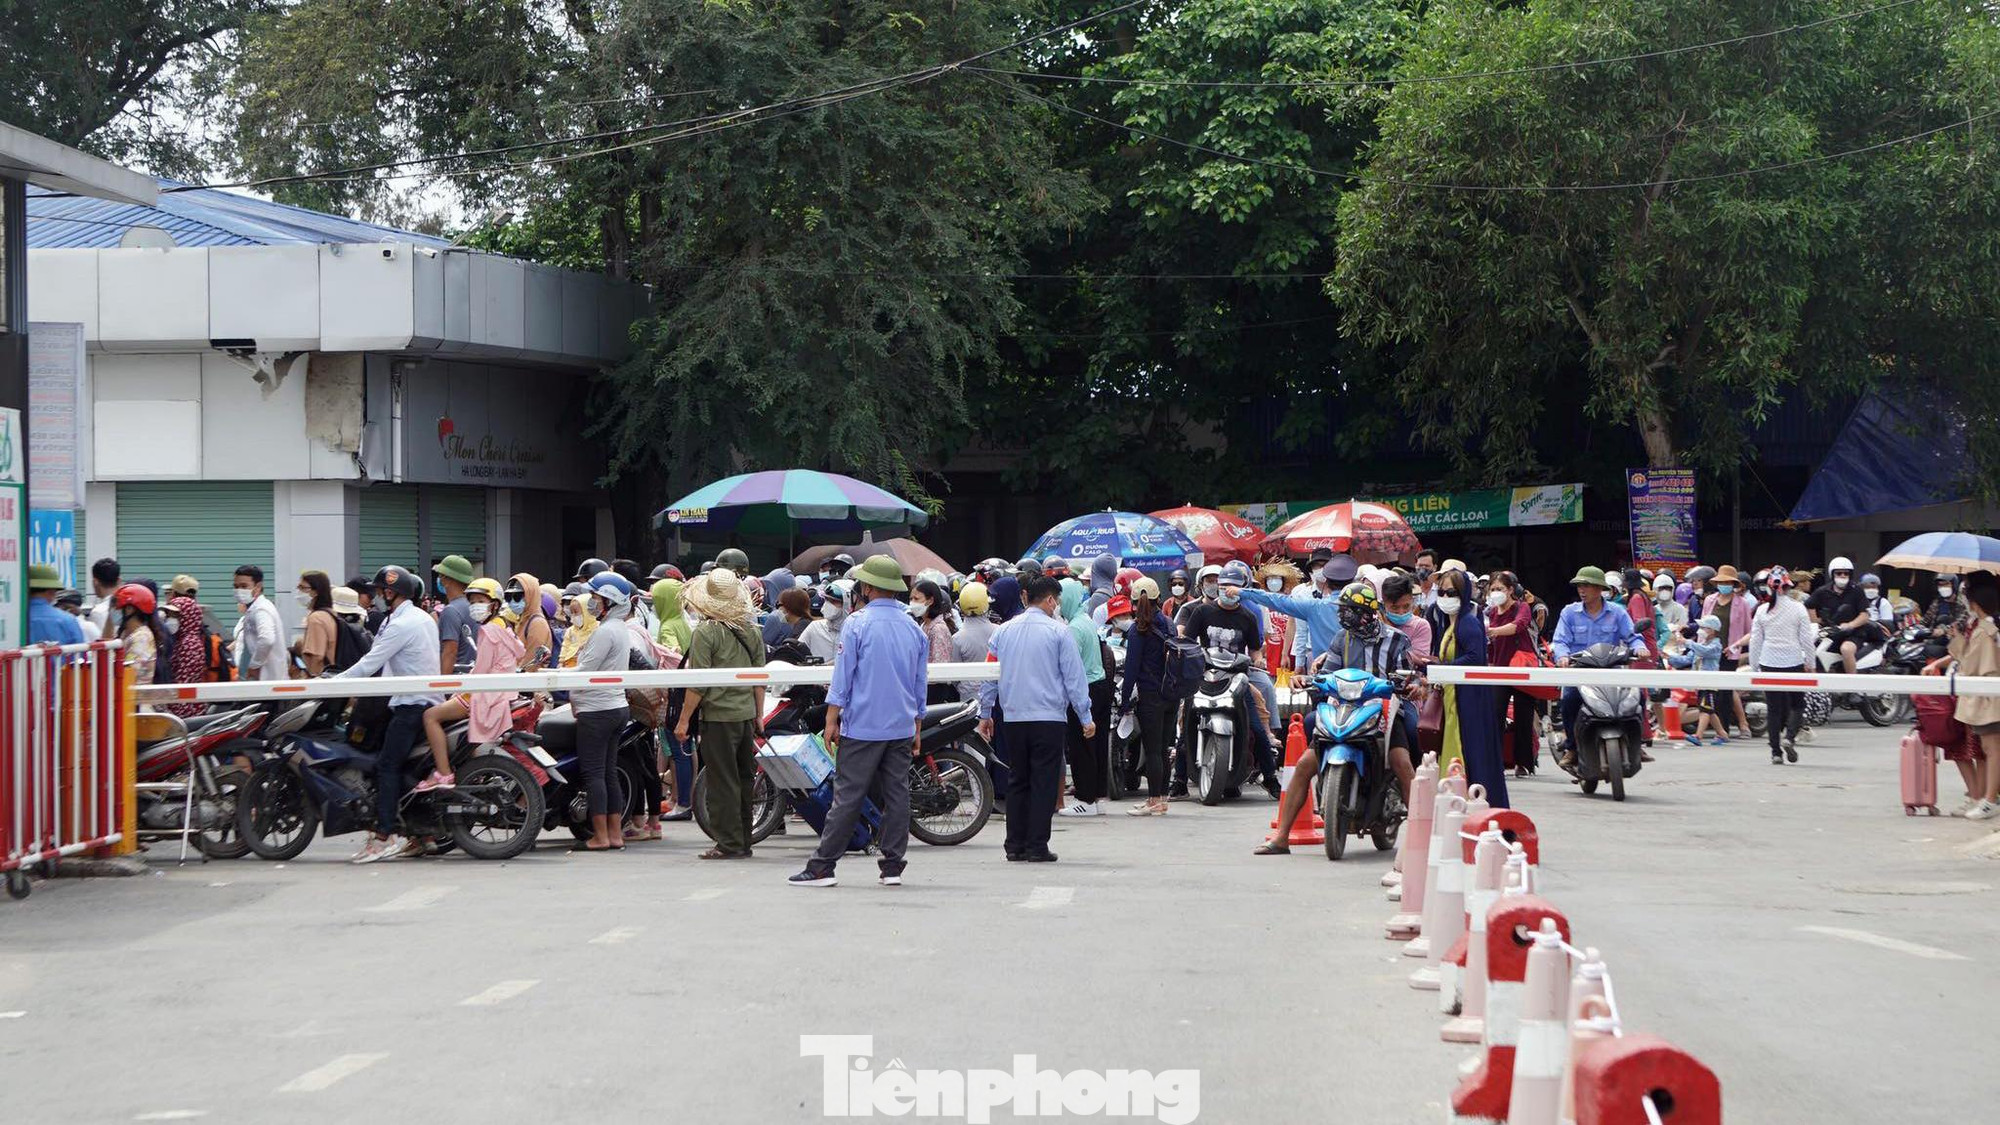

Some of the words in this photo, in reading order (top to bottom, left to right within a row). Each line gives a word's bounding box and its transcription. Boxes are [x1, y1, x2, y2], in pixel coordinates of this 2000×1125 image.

[1413, 494, 1450, 511] LIÊN
[1520, 491, 1544, 514] Sprite
[1433, 511, 1459, 523] CÁC
[1461, 510, 1489, 522] LOẠI
[1071, 526, 1115, 536] AQUARIUS
[1071, 544, 1084, 556] 0
[1304, 538, 1336, 550] Coca-Cola
